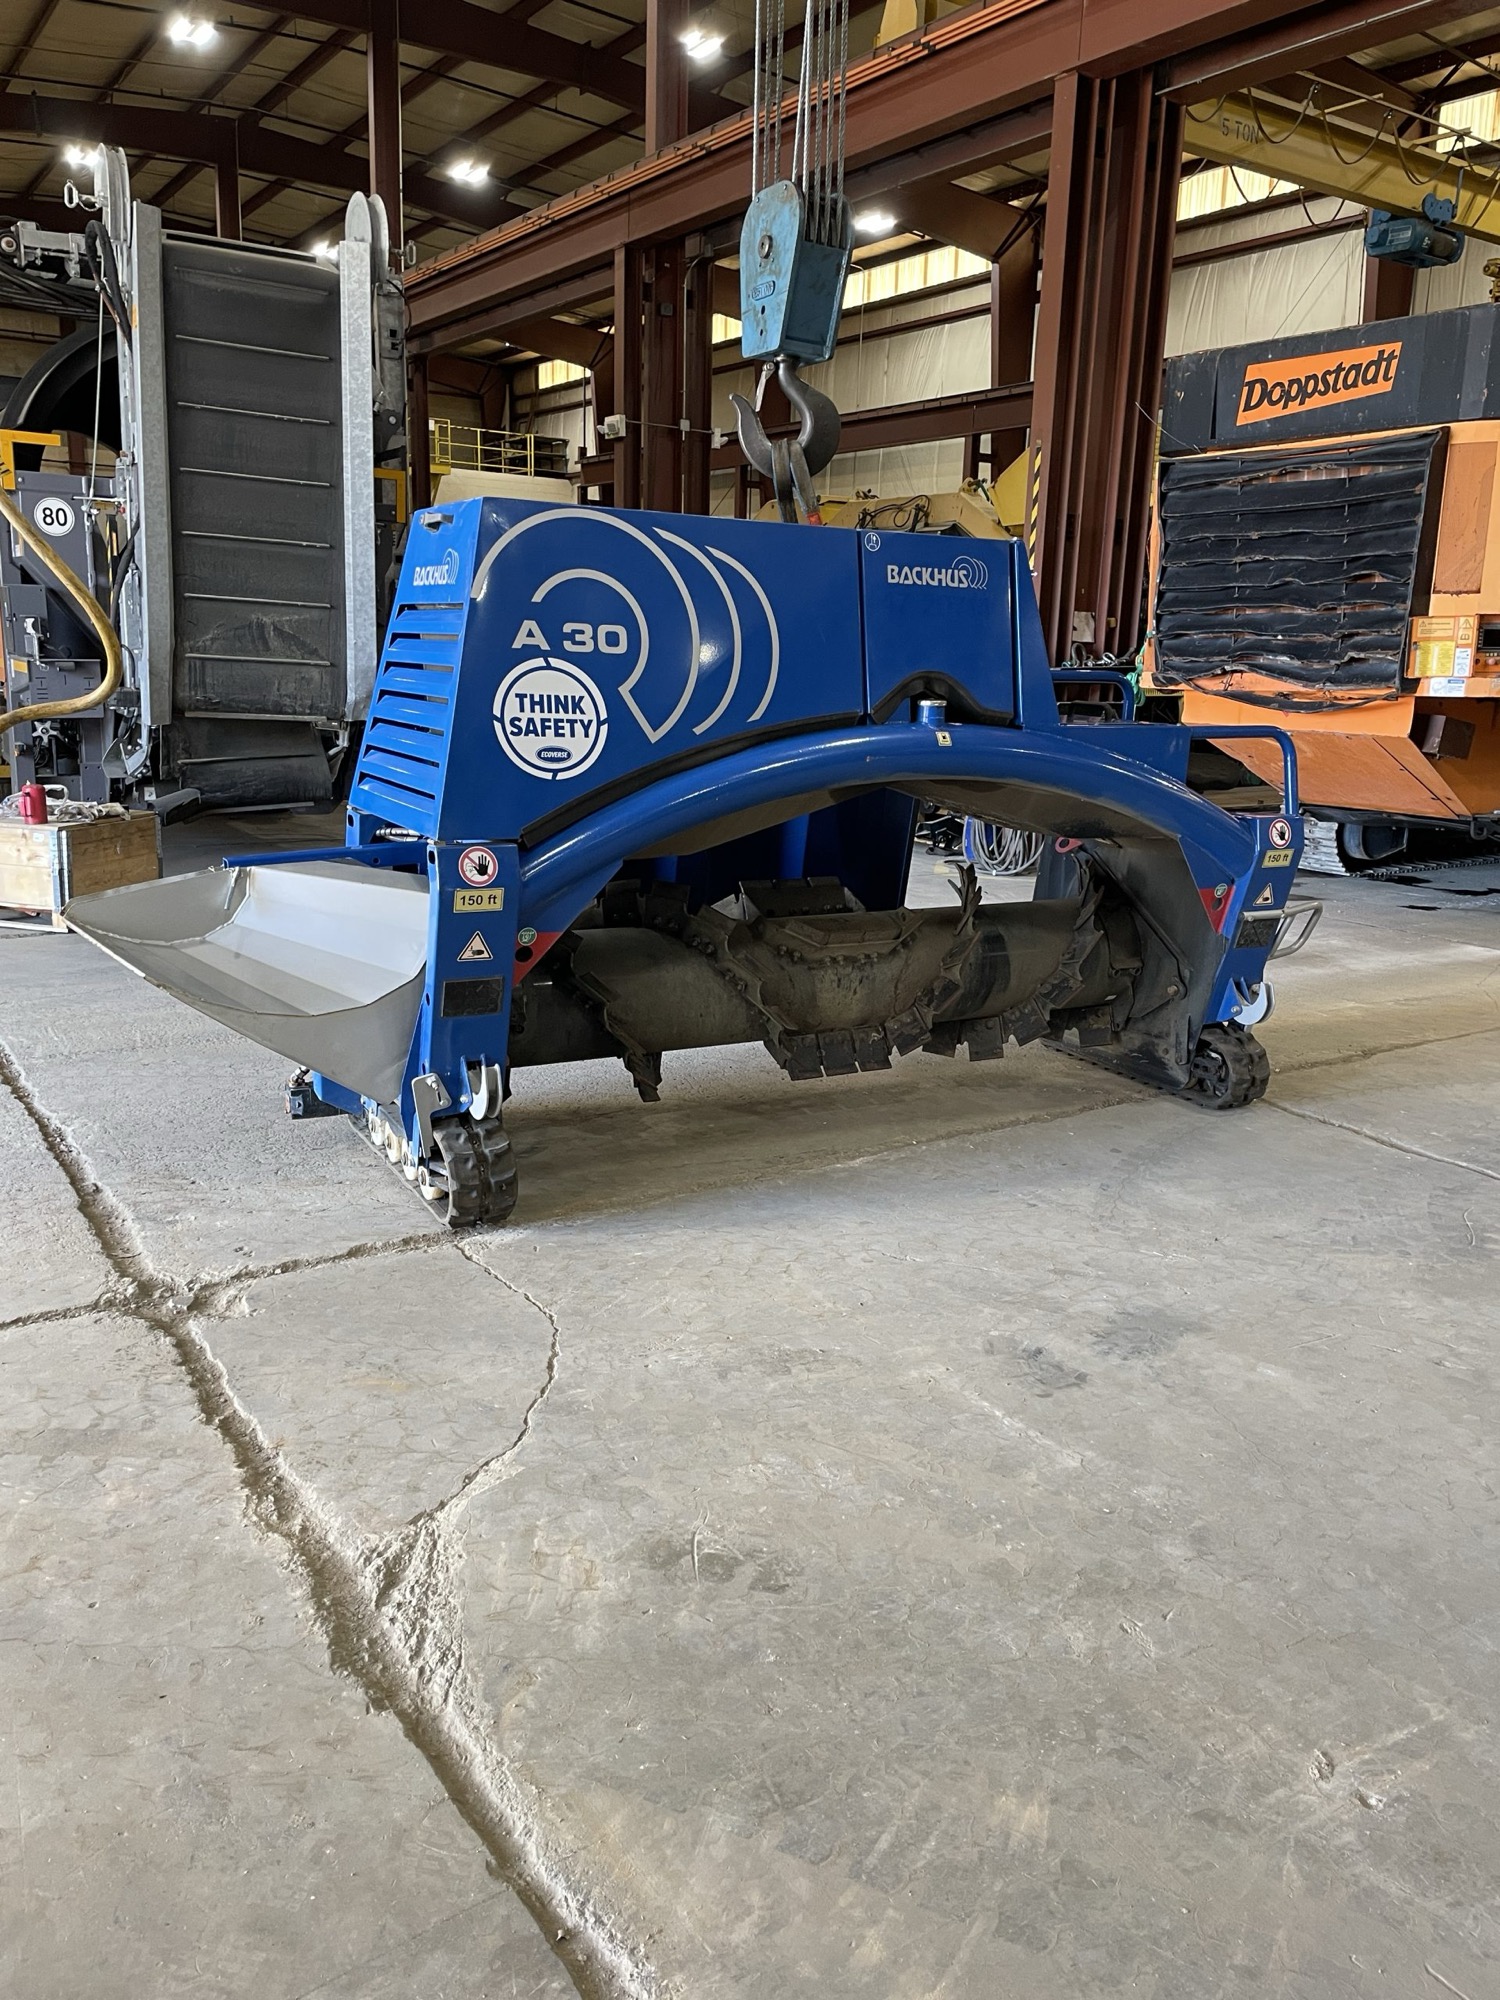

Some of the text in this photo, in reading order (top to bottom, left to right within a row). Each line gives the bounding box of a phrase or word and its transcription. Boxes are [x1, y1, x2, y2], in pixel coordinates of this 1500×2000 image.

[1222, 118, 1260, 144] 5 TON
[1242, 349, 1398, 412] Doppstadt
[42, 507, 67, 526] 80
[413, 565, 449, 586] BACKHUS
[887, 565, 969, 588] BACKHUS
[511, 619, 628, 654] A 30
[514, 692, 586, 715] THINK
[509, 716, 594, 738] SAFETY
[540, 751, 568, 759] ECOVERSE
[1267, 853, 1289, 863] 150 ft
[460, 894, 498, 906] 150 ft
